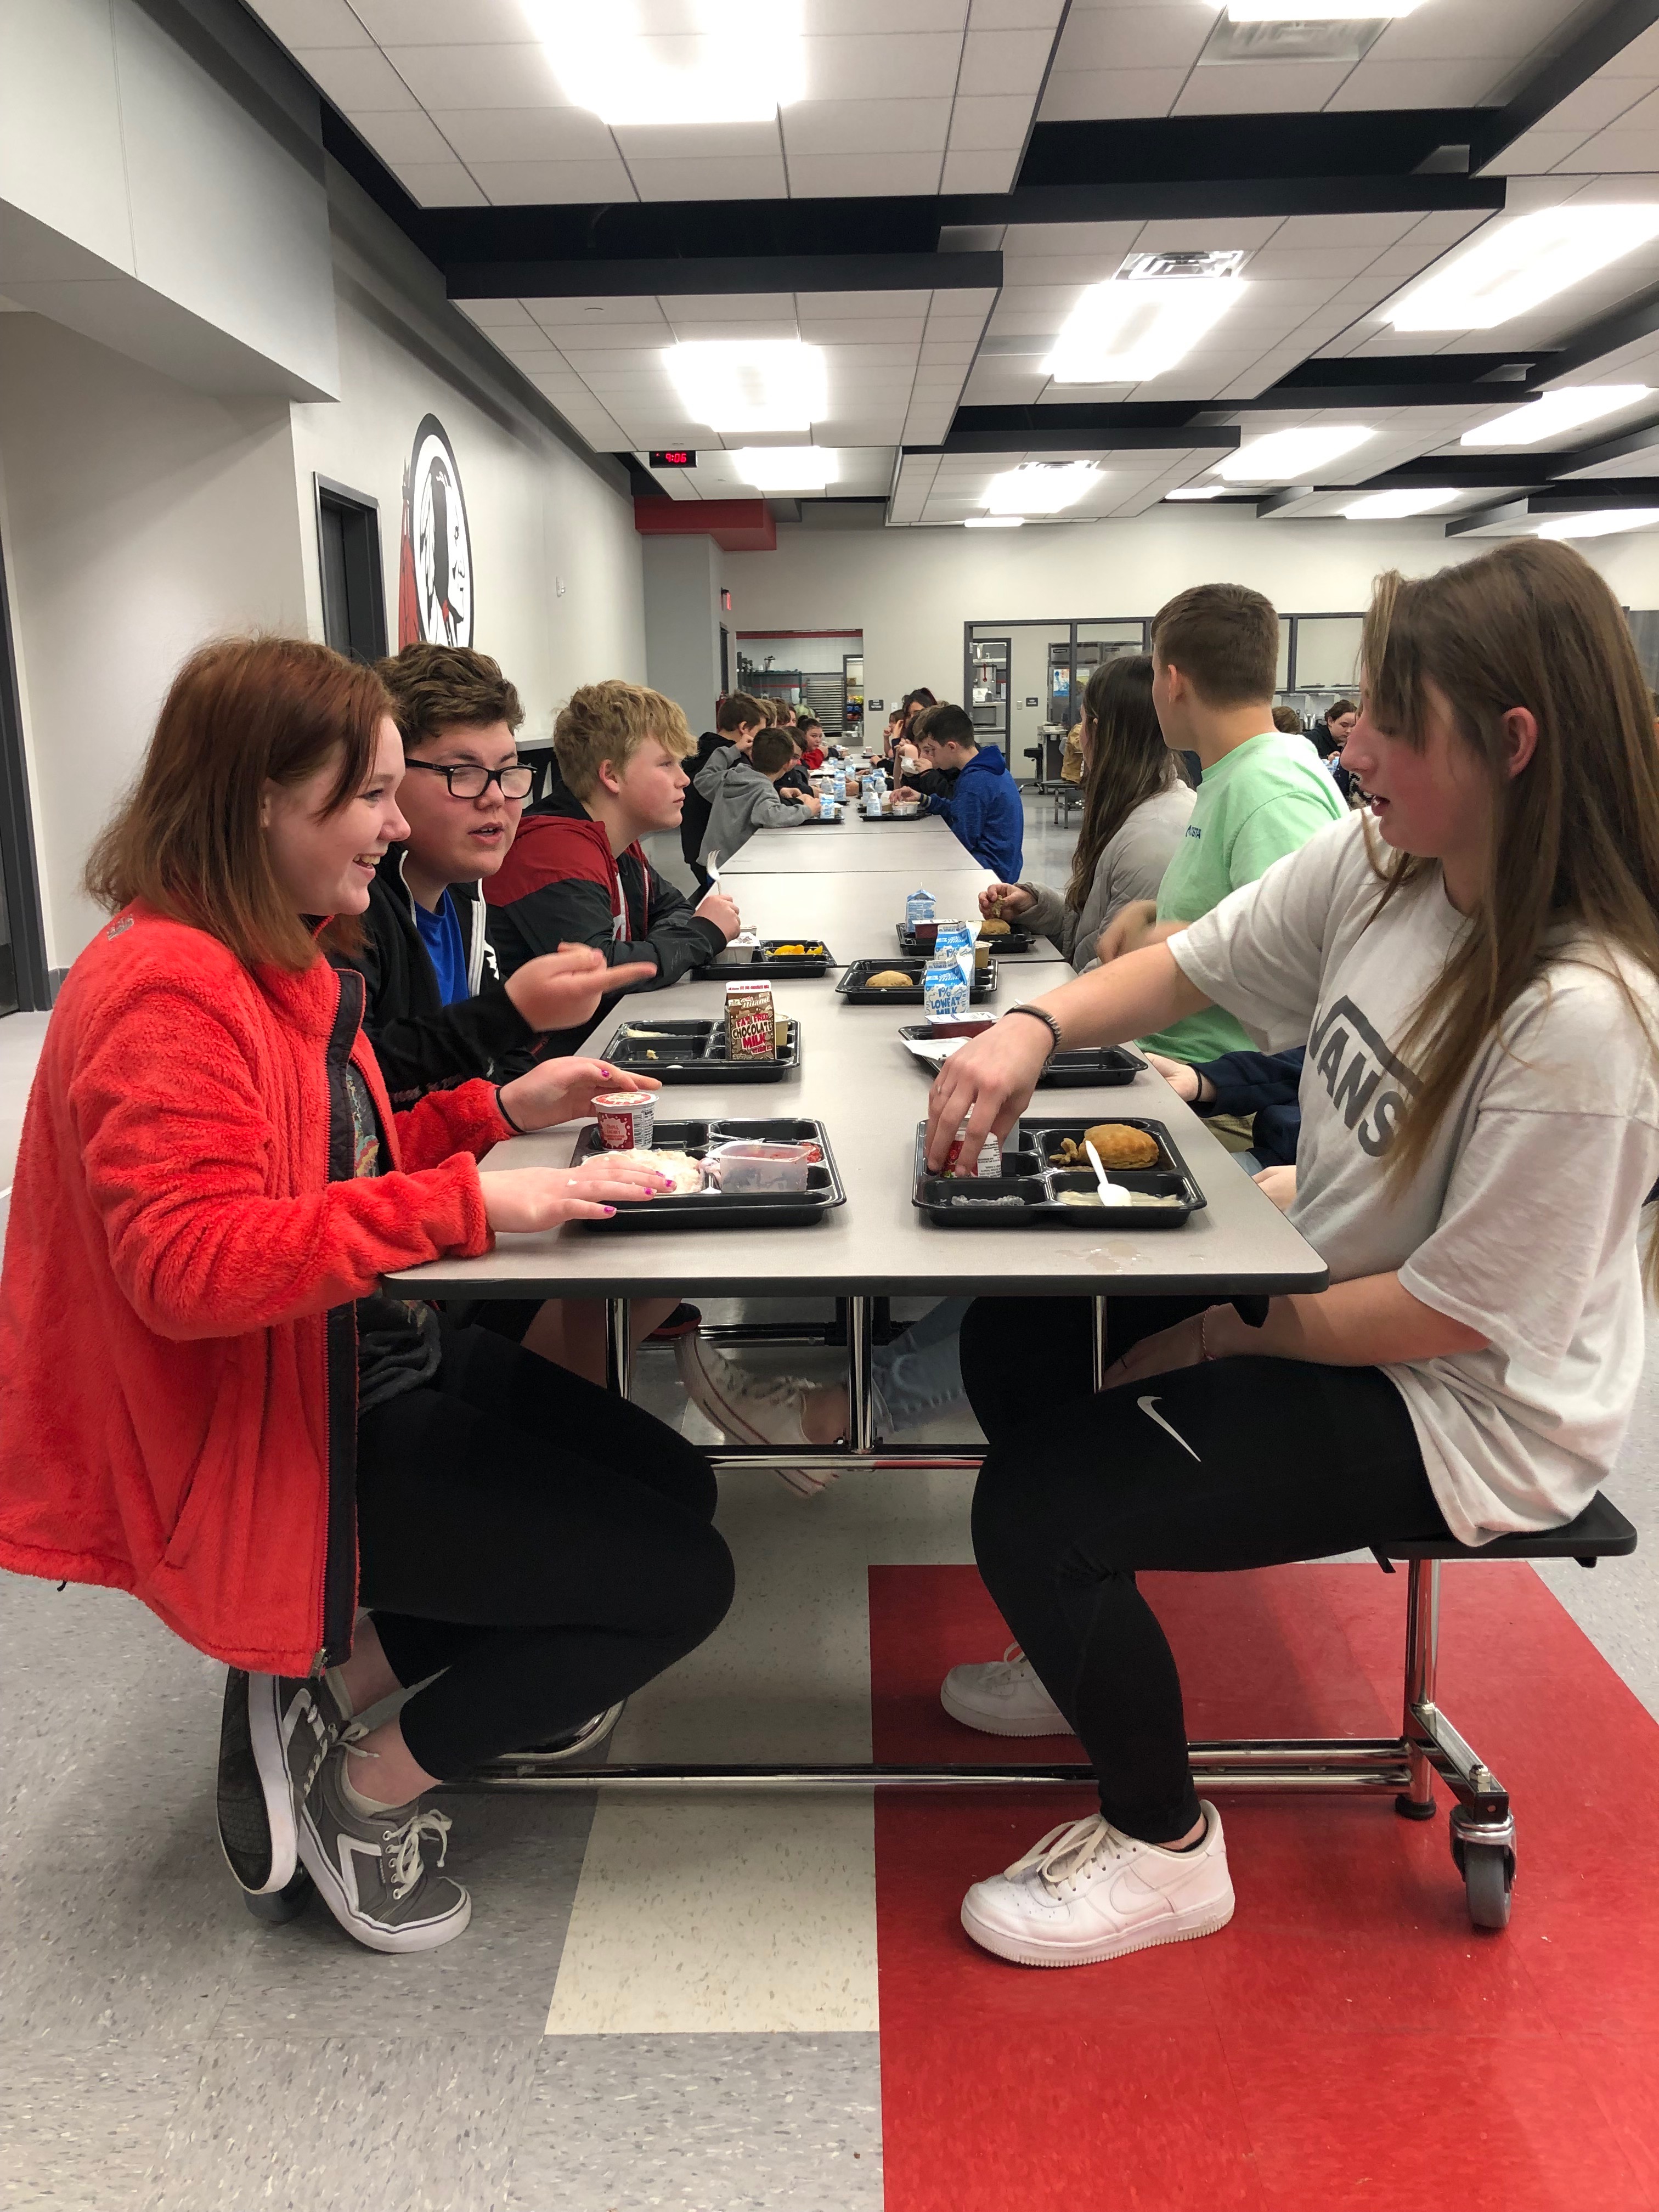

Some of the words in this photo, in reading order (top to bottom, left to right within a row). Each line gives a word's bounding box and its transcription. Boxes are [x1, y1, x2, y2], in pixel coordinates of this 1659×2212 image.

[938, 987, 951, 997] 1%
[931, 997, 960, 1009] LOWFAT
[736, 1016, 751, 1028] FAT
[753, 1013, 769, 1023] FREE
[732, 1022, 772, 1039] CHOCOLATE
[742, 1032, 766, 1048] MILK
[1308, 995, 1424, 1157] VANS
